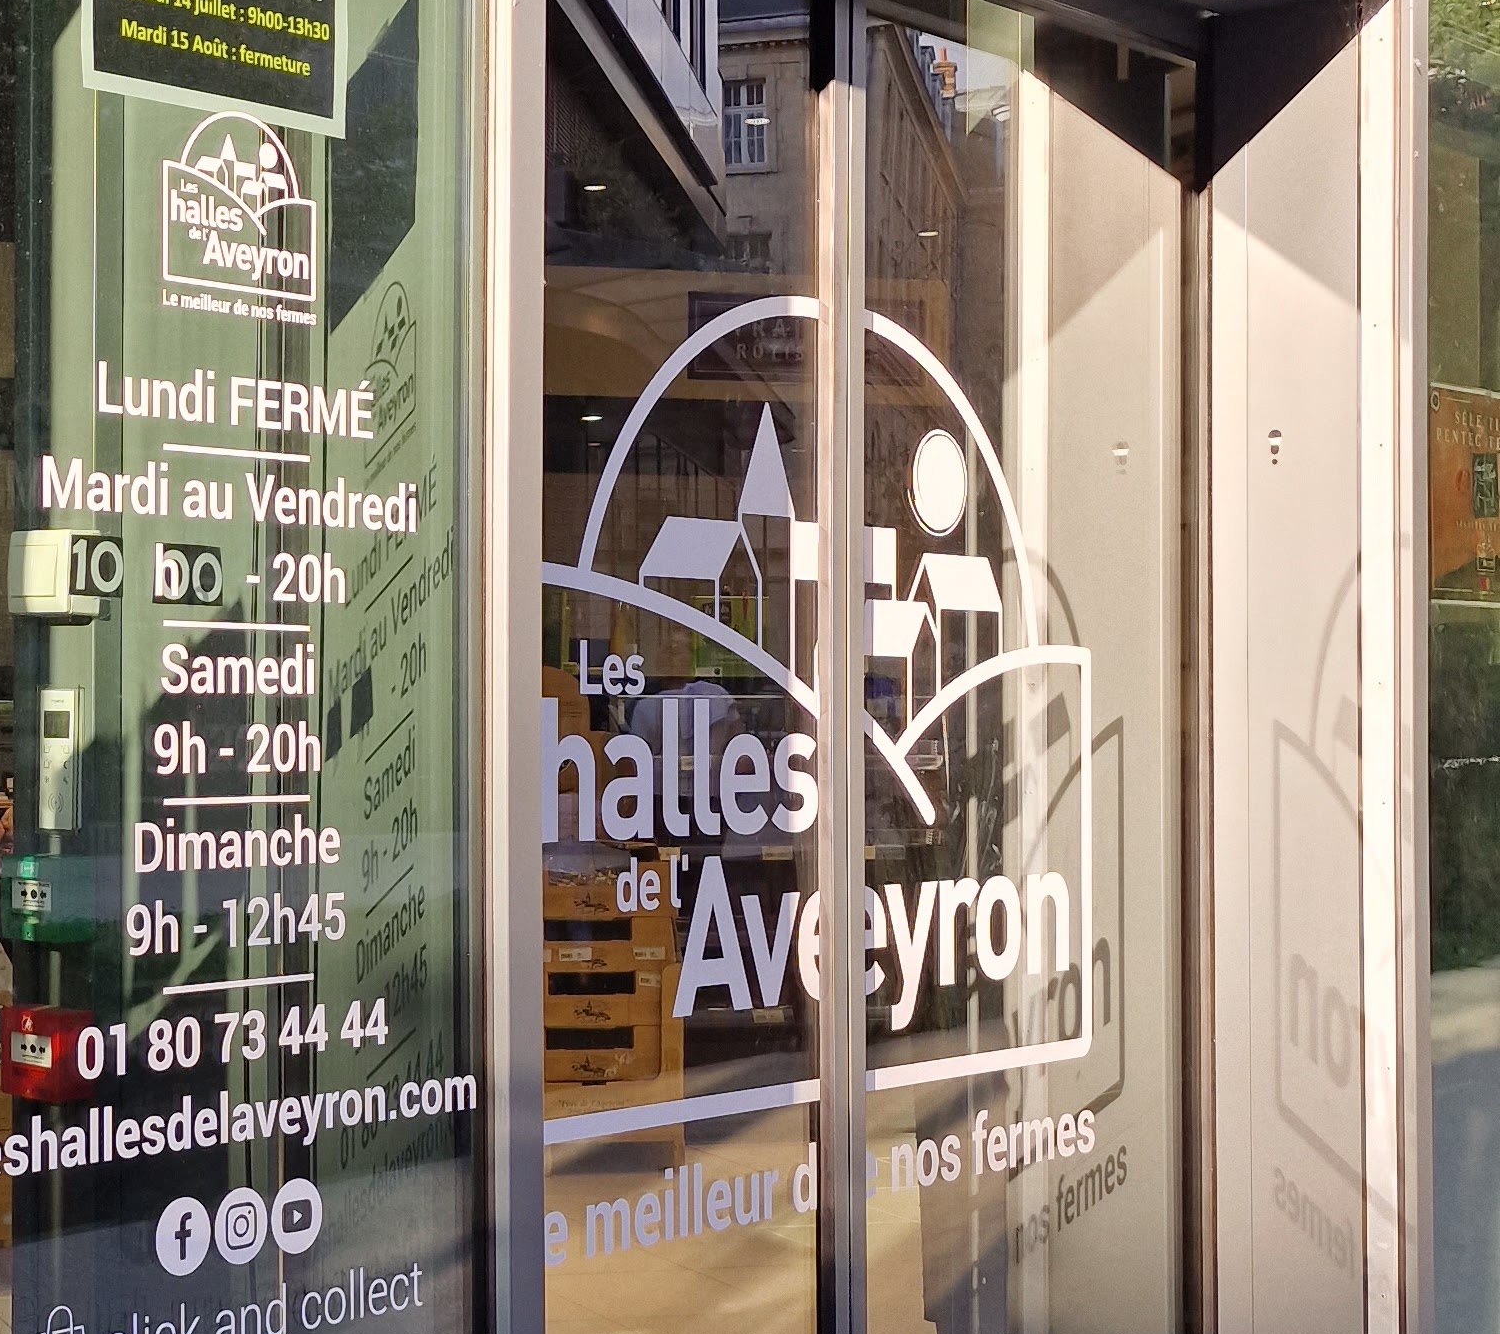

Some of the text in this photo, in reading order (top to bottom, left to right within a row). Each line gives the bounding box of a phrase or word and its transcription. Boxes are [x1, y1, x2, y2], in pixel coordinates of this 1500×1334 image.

[121, 19, 167, 46] Mardi
[171, 29, 189, 49] 15
[192, 32, 228, 59] Août
[240, 43, 310, 76] fermeture
[248, 1, 329, 41] 9h00-13h30
[171, 189, 243, 231] halles
[181, 179, 198, 193] Les
[189, 226, 201, 239] de
[163, 289, 316, 325] Le meilleur de nos fermes
[98, 361, 374, 439] Lundi FERMÉ
[41, 455, 418, 533] Mardi au Vendredi
[73, 539, 123, 594] 10
[272, 551, 346, 604] 20h
[161, 643, 315, 696] Samedi
[578, 638, 645, 698] Les
[154, 722, 205, 776] 9h
[247, 720, 321, 774] 20h
[541, 698, 818, 843] halles
[135, 813, 340, 874] Dimanche
[616, 856, 660, 913] de
[126, 899, 178, 956] 9h
[224, 892, 346, 947] 12h45
[77, 997, 388, 1080] 01 80 73 44 44
[584, 1163, 779, 1260] meilleur
[891, 1130, 960, 1194] nos
[972, 1108, 1096, 1176] fermes
[301, 1262, 423, 1331] collect
